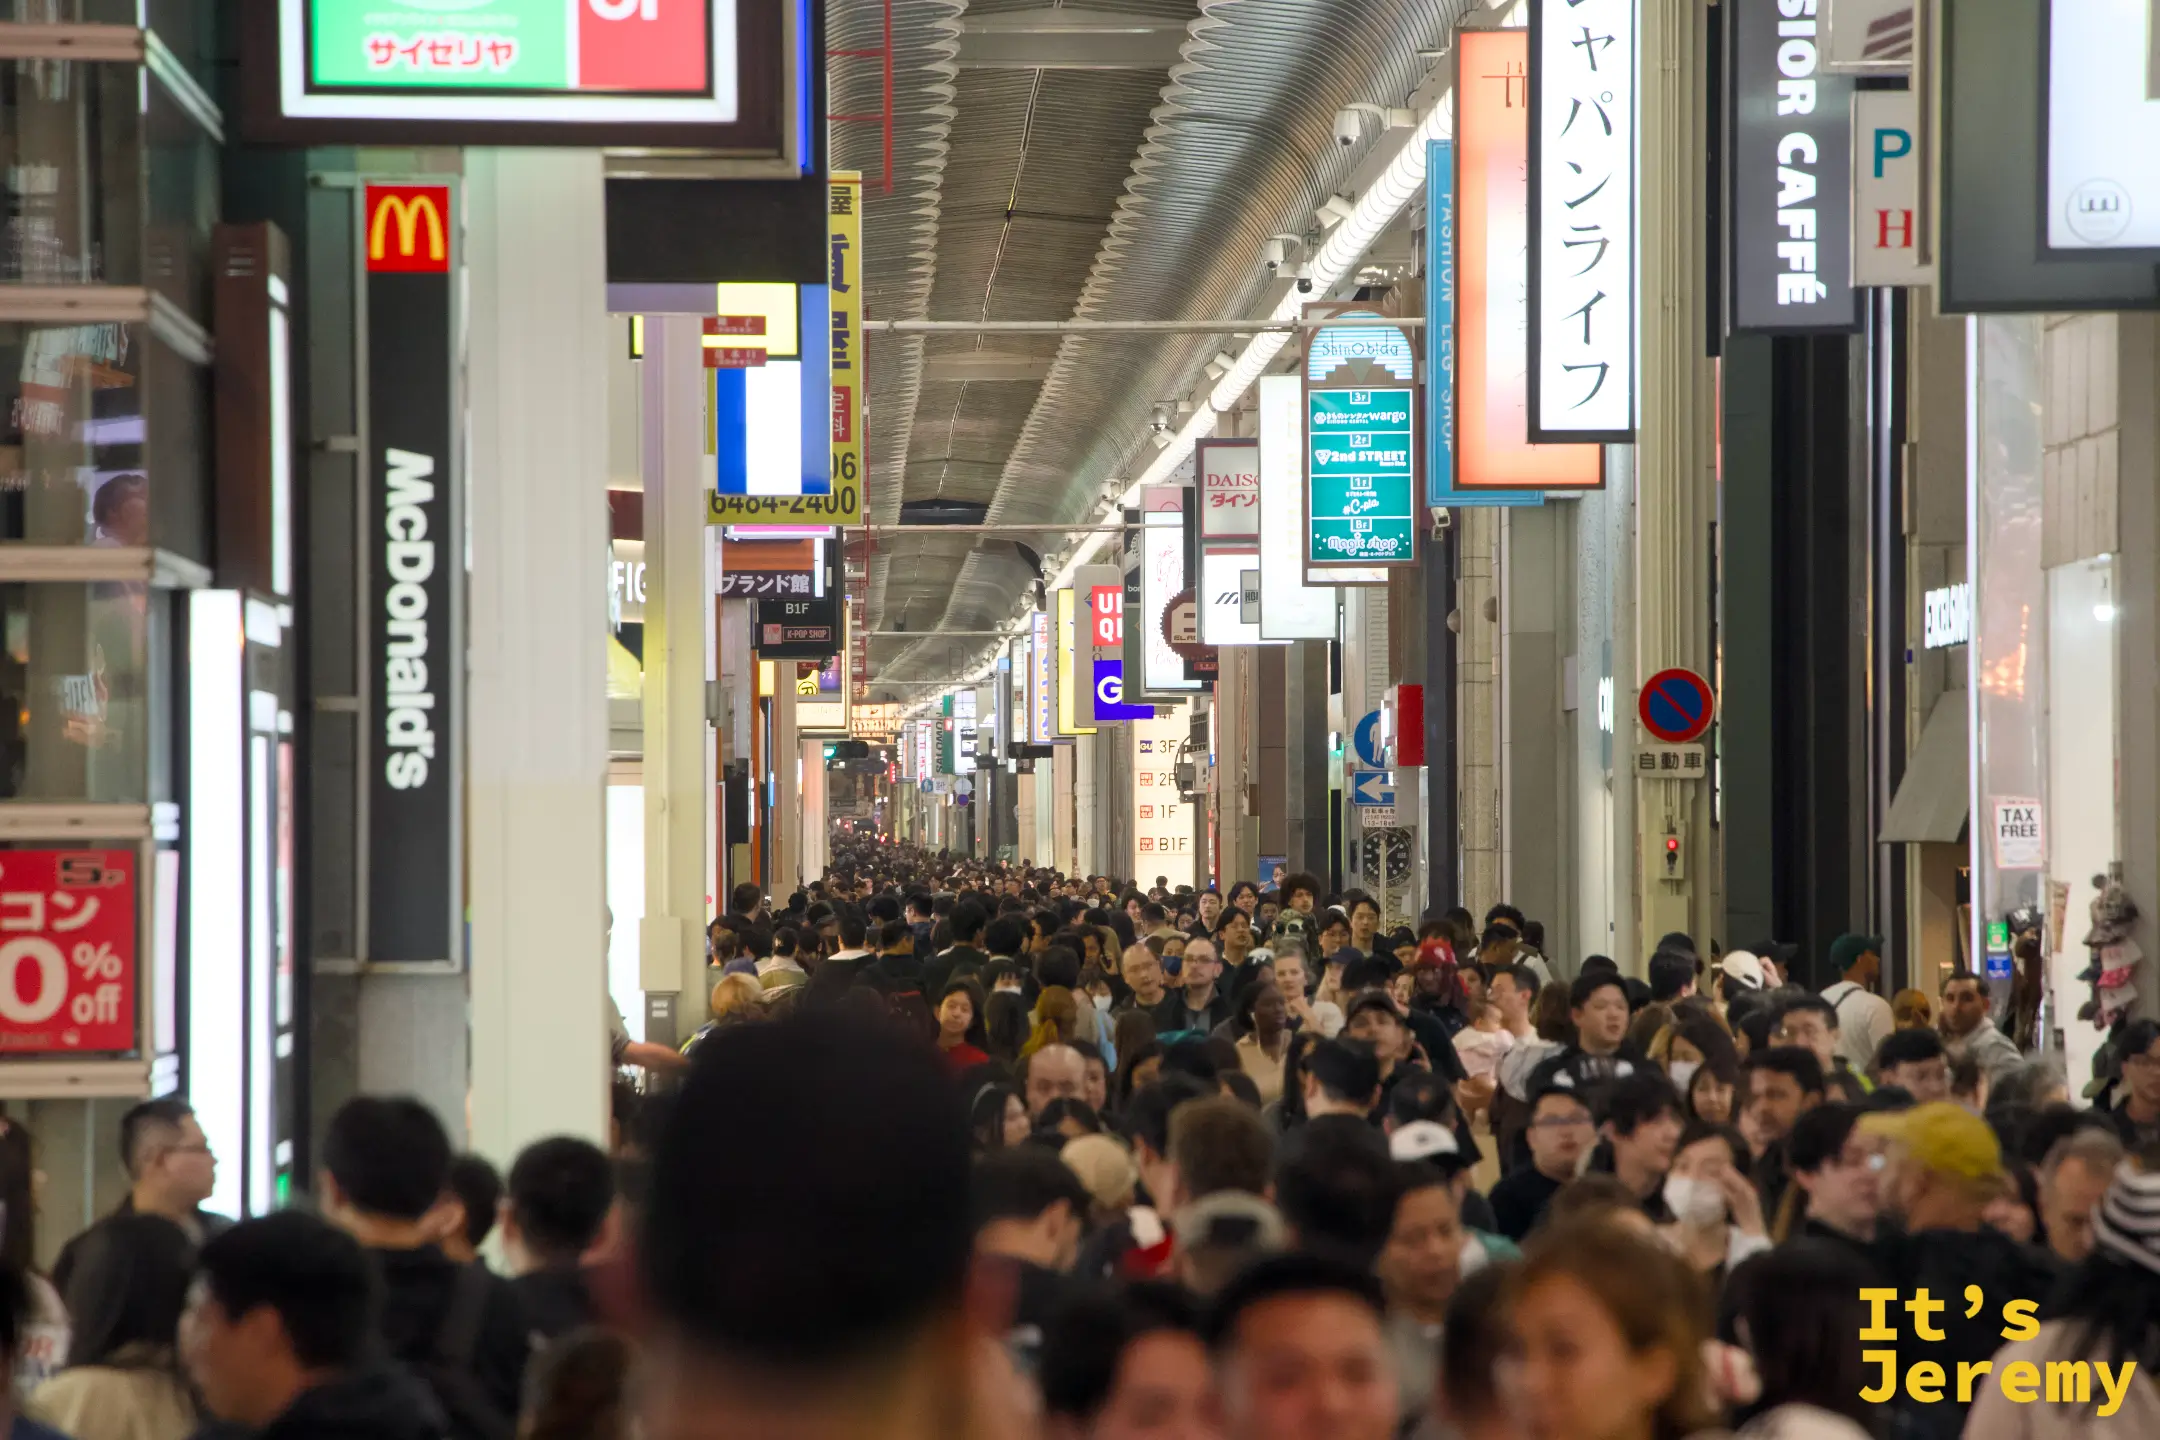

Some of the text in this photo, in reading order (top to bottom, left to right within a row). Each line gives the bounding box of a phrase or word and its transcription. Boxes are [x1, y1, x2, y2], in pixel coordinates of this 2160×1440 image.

[1874, 128, 1912, 178] P
[1559, 0, 1617, 411] ャパンライフ
[1777, 132, 1827, 305] CAFFÉ
[1874, 208, 1913, 249] H
[1370, 411, 1407, 424] wargo
[1330, 451, 1407, 463] 2nd STREET
[1210, 494, 1258, 508] ダイソ
[722, 574, 810, 593] ブランド館
[785, 603, 810, 614] B1F
[386, 448, 434, 790] McDonald's
[787, 630, 807, 638] K-POP
[809, 630, 827, 638] SHOP
[1140, 742, 1152, 751] GU
[1159, 740, 1177, 753] 3F
[1639, 752, 1701, 770] 自動車
[1159, 773, 1176, 786] 2F
[1160, 805, 1177, 818] 1F
[2003, 808, 2035, 822] TAX
[2000, 824, 2038, 839] FREE
[1159, 838, 1188, 851] B1F
[71, 983, 122, 1024] off
